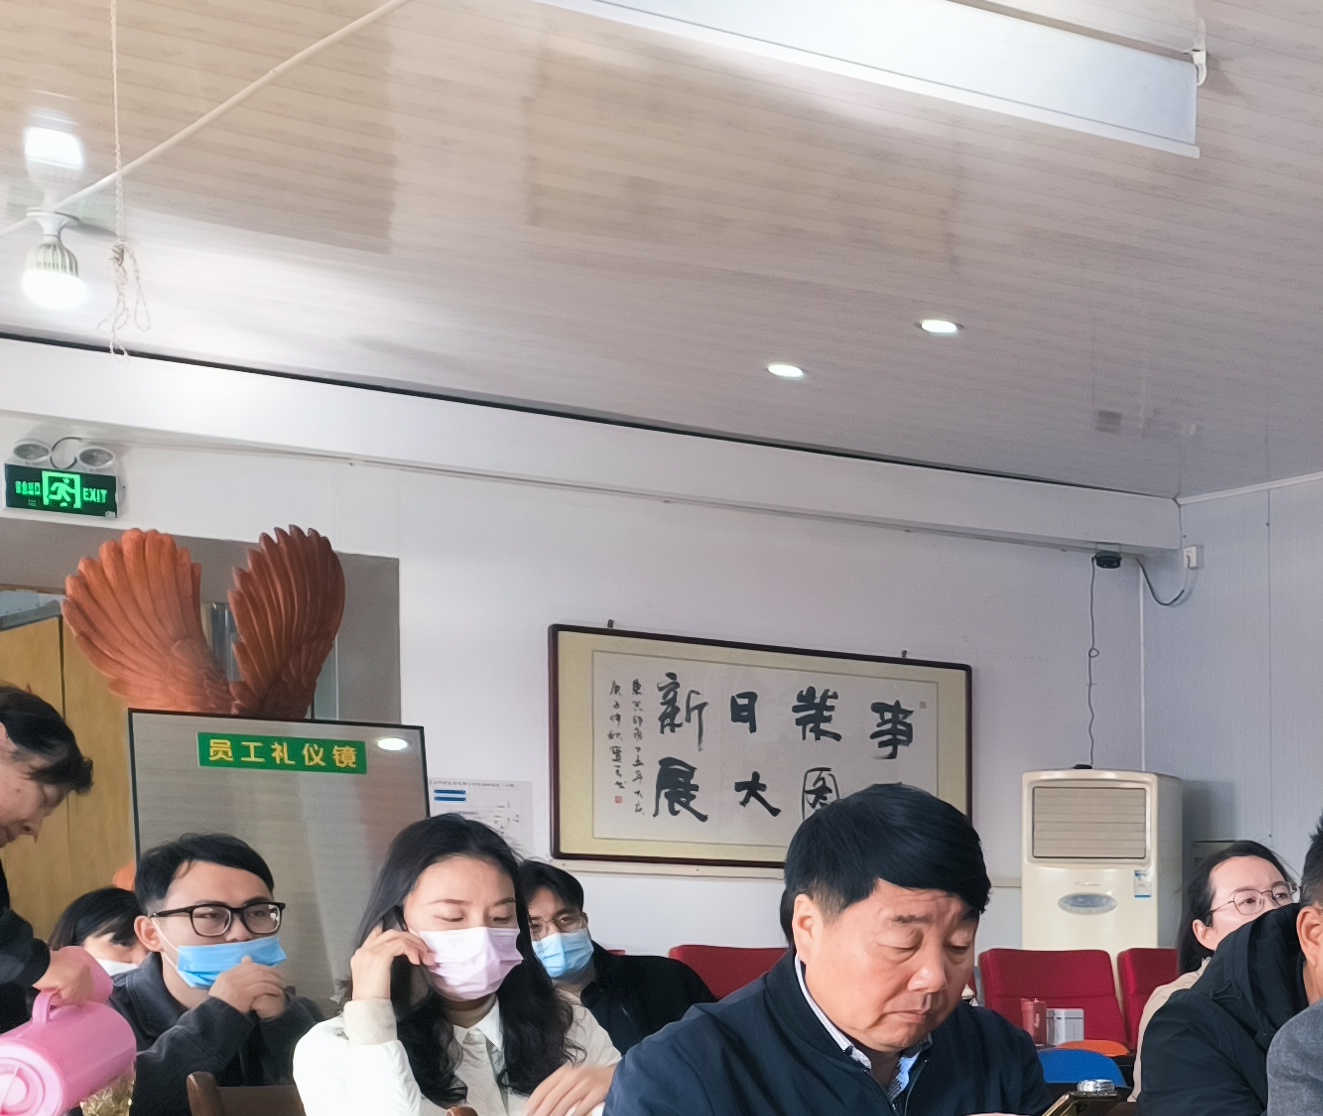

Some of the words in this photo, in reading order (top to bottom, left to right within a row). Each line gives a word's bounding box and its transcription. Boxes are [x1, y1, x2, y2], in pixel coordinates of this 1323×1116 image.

[82, 487, 108, 504] EXIT
[208, 738, 357, 769] 员工礼仪镜
